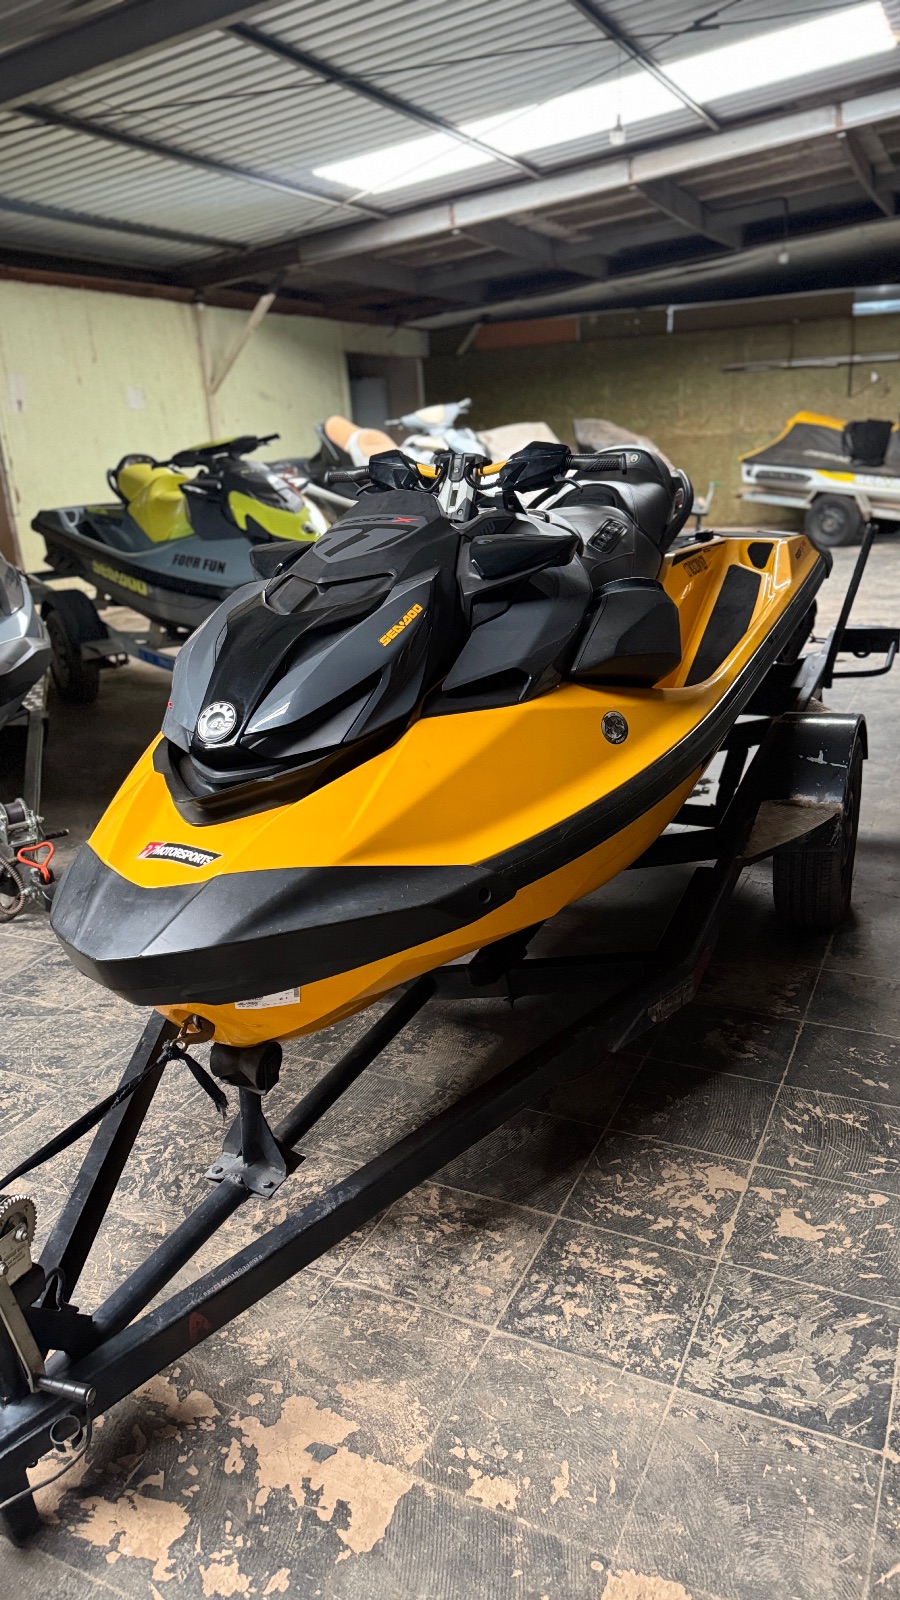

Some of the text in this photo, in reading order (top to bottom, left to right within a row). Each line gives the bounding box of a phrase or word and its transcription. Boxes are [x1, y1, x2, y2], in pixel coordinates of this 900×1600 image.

[172, 554, 227, 574] FOUR FUN
[152, 846, 214, 865] MOTORSPORTS
